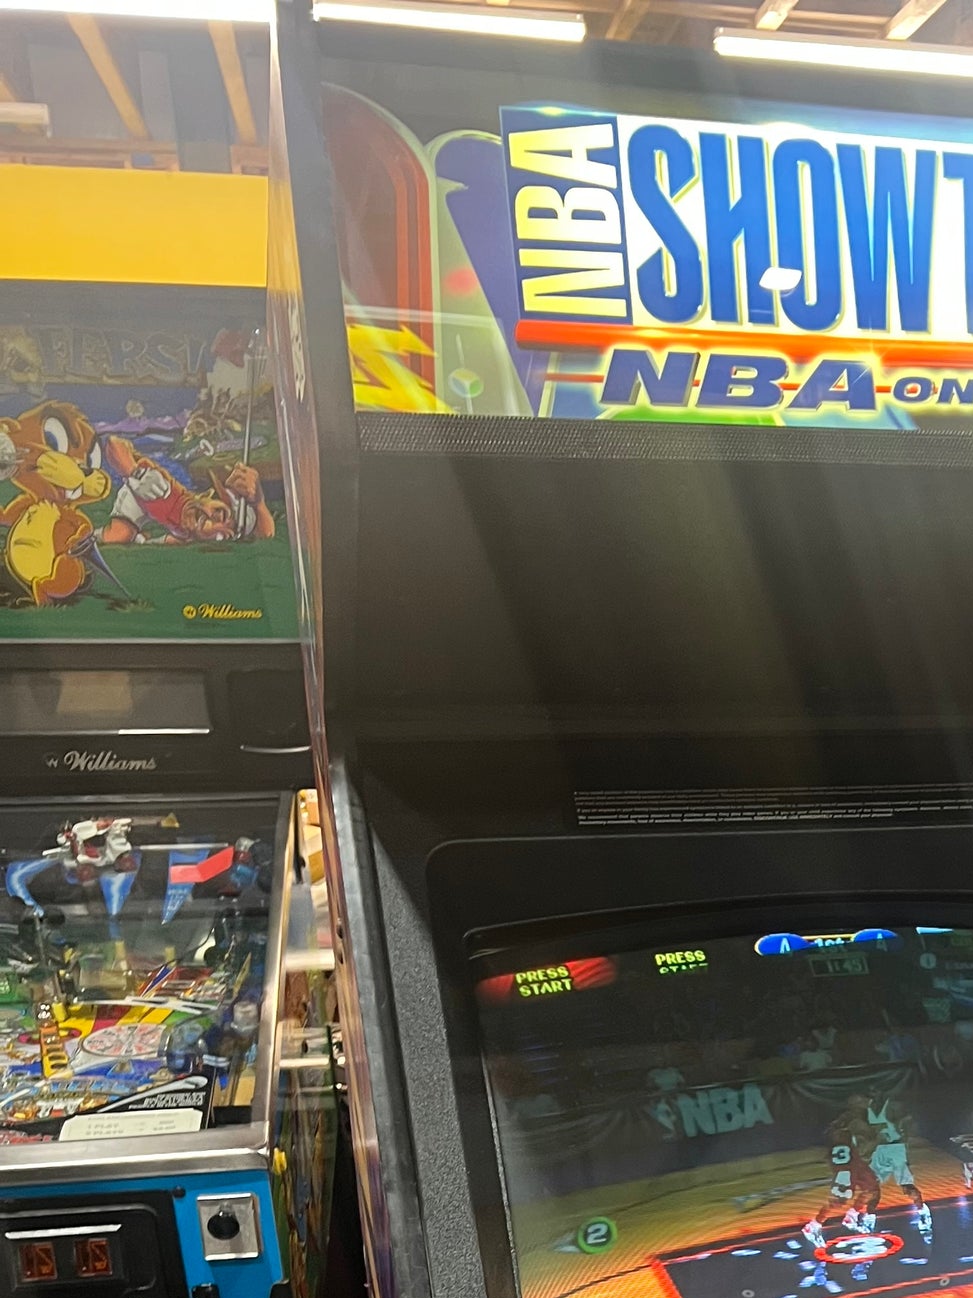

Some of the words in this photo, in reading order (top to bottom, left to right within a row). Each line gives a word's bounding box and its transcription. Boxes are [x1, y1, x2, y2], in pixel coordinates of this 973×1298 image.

[508, 122, 628, 318] NBA
[600, 348, 878, 411] NBA
[199, 604, 262, 620] Williams
[63, 750, 157, 771] Williams
[655, 949, 707, 966] PRESS
[515, 965, 570, 984] PRESS
[518, 978, 573, 997] START
[677, 1083, 774, 1137] NBA
[586, 1223, 609, 1245] 2
